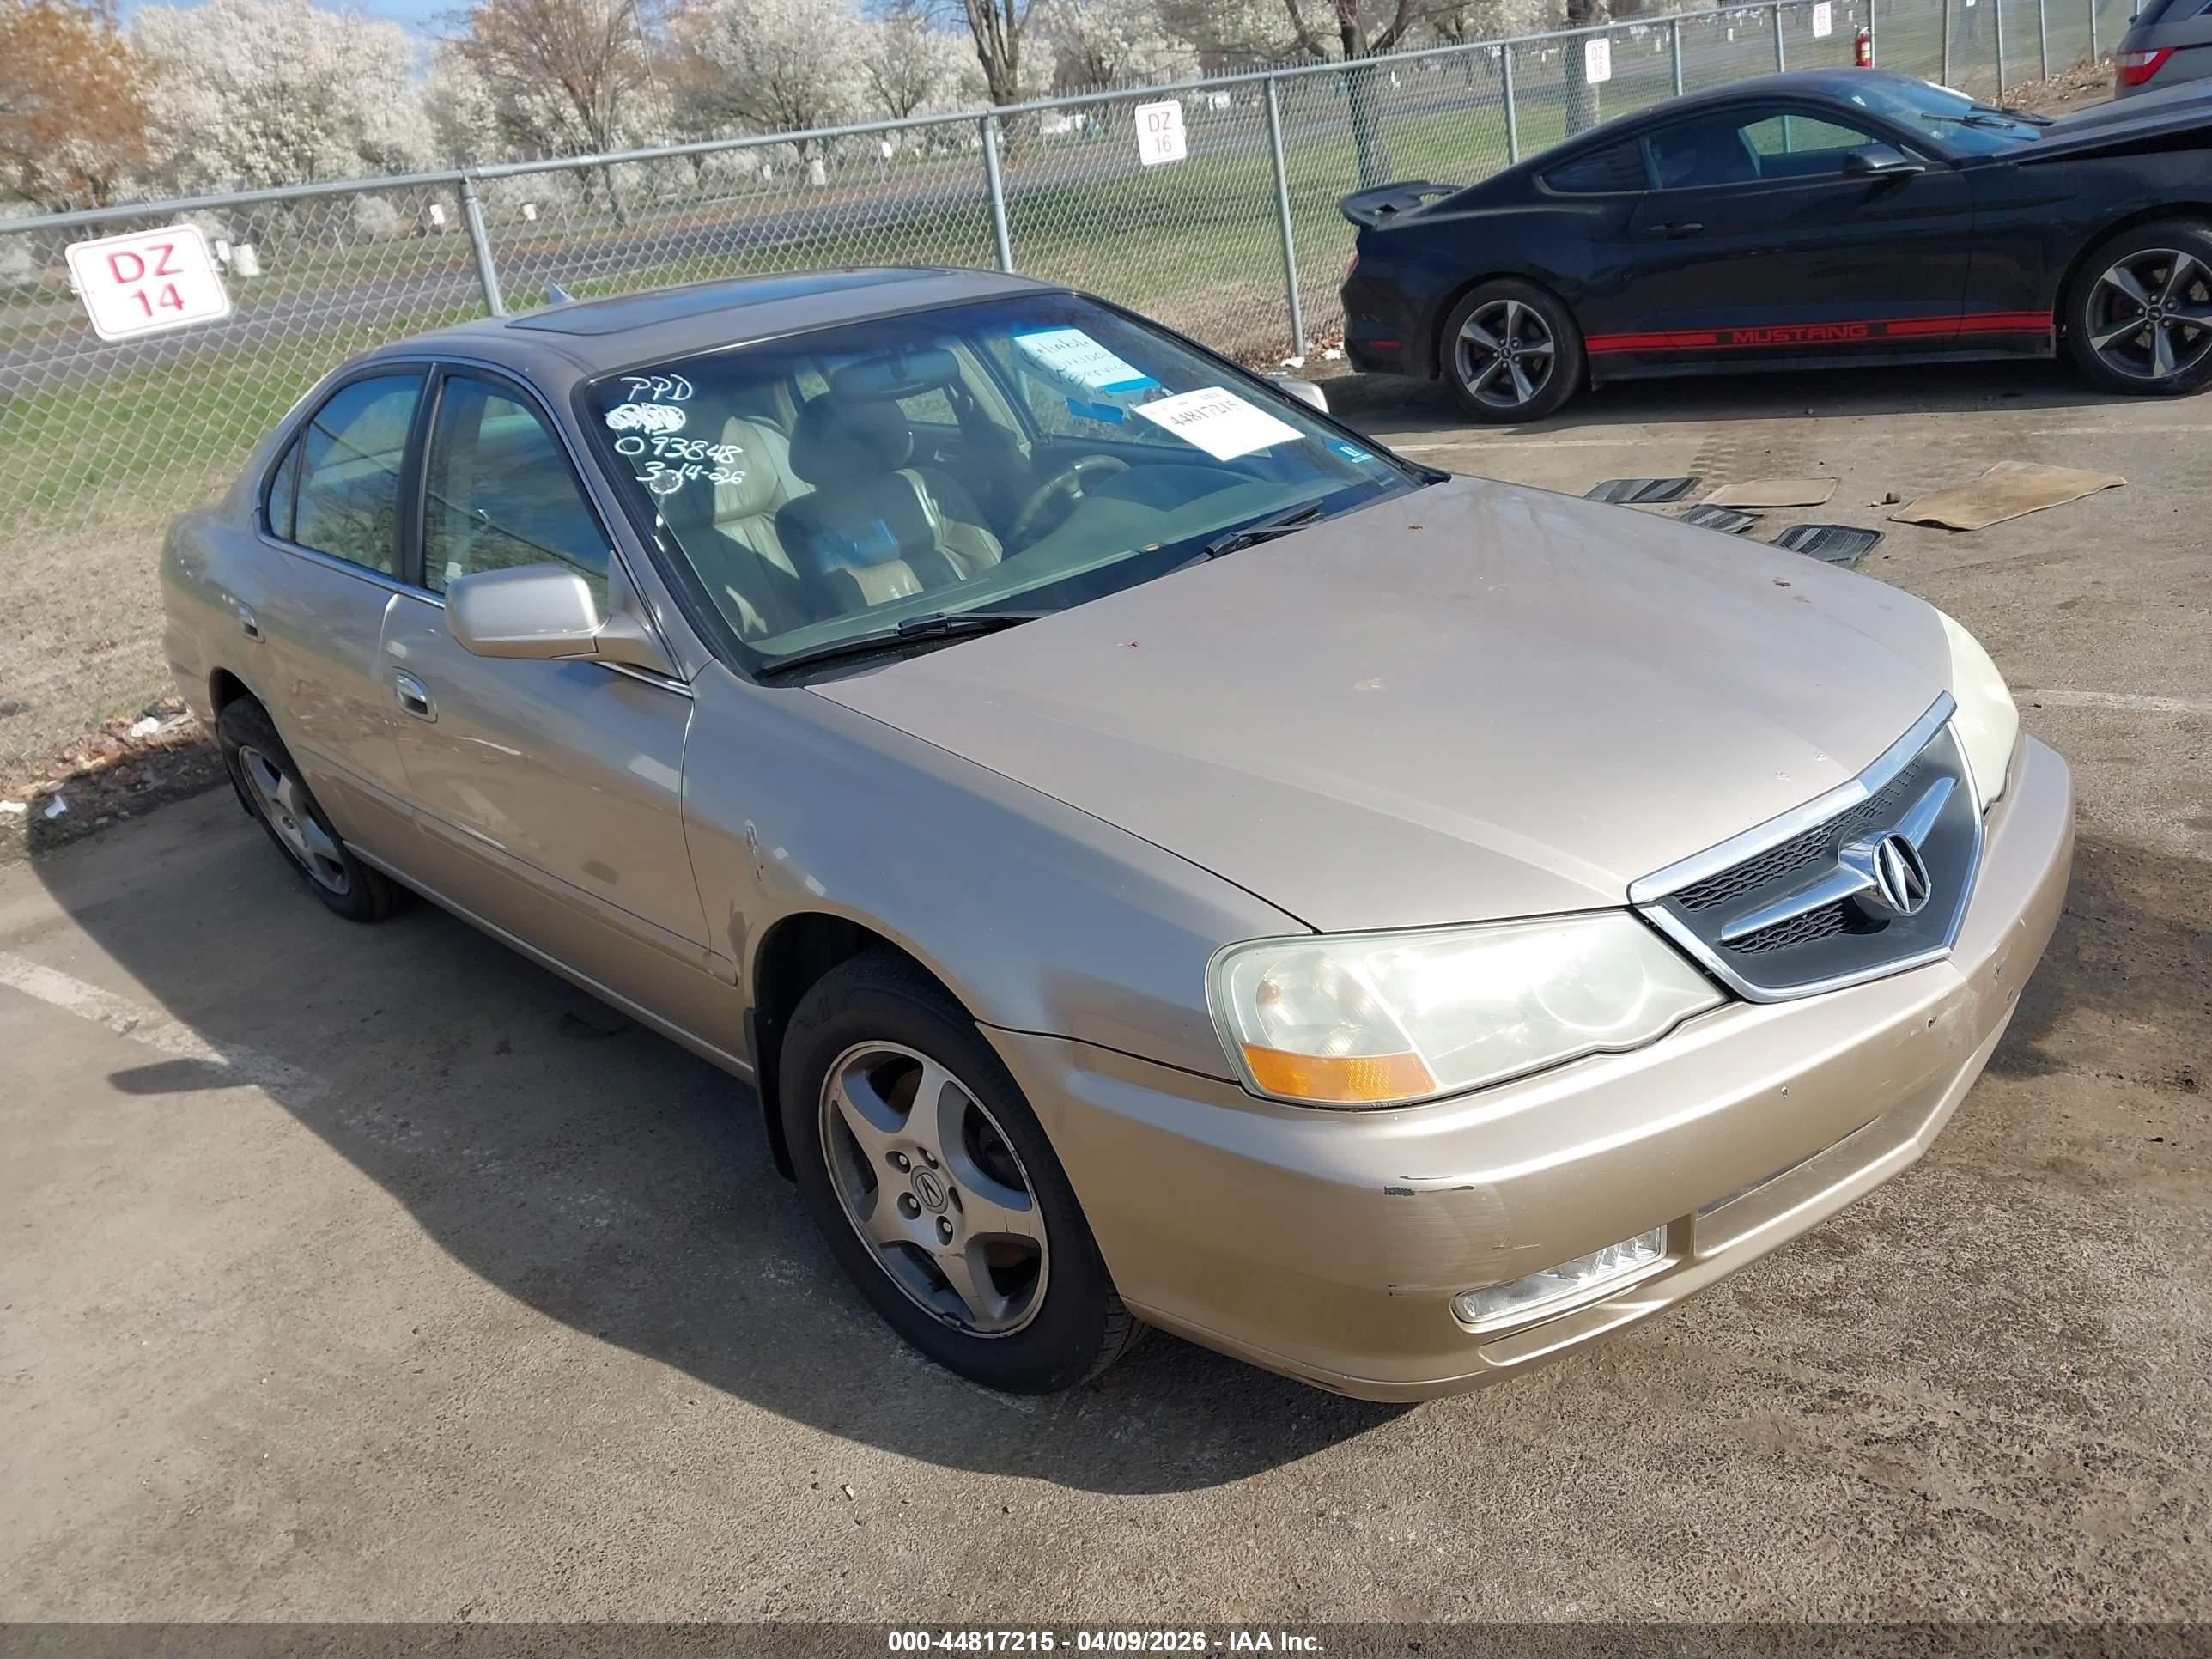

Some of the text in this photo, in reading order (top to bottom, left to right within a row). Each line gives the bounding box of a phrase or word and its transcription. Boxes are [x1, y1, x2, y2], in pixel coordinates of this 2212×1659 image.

[1148, 112, 1172, 132] DZ
[1155, 134, 1172, 154] 16
[106, 244, 184, 283] DZ
[131, 283, 185, 317] 14
[1732, 324, 1868, 343] MUSTANG
[620, 374, 692, 402] PPD
[1171, 400, 1242, 426] 44817215
